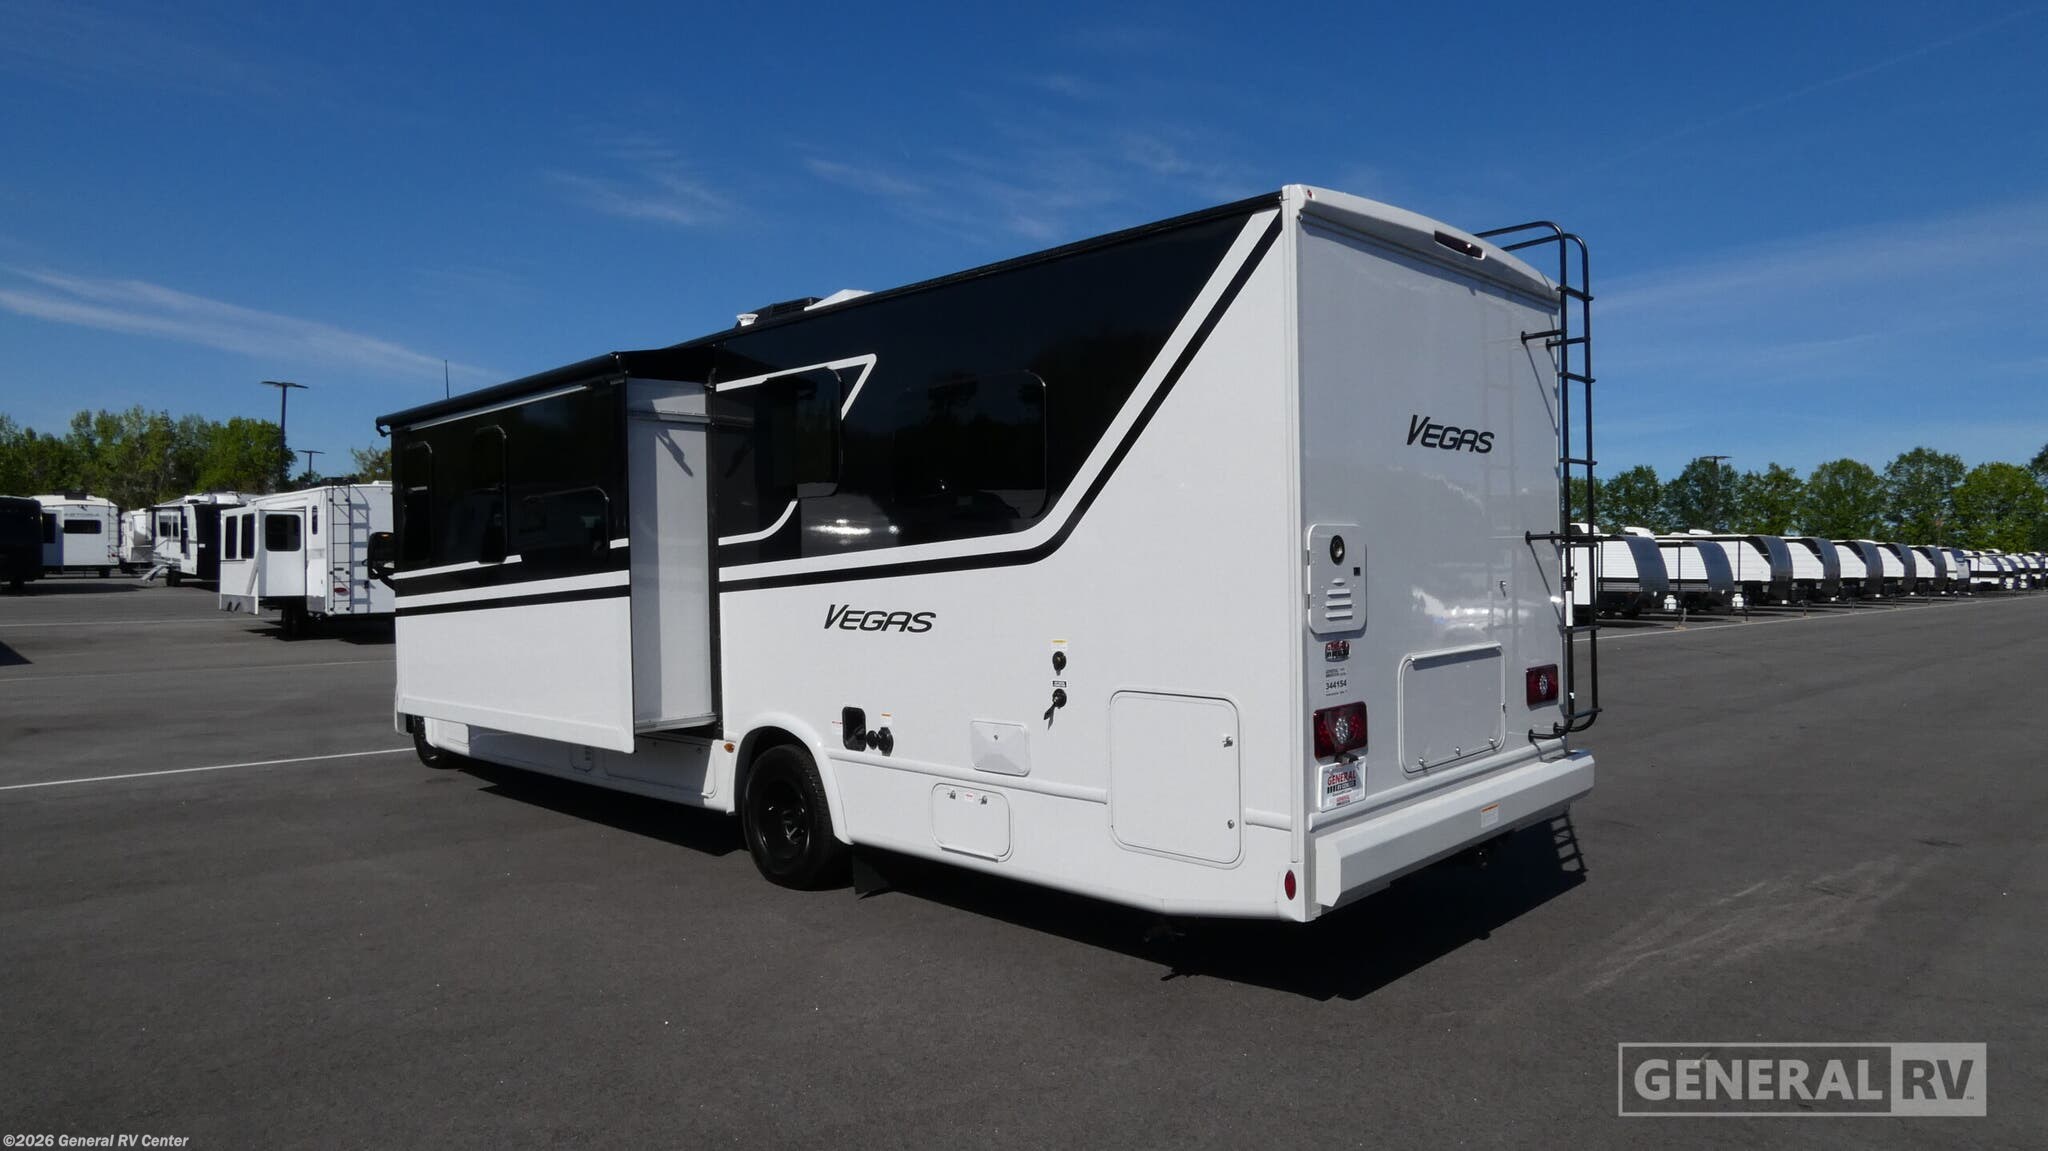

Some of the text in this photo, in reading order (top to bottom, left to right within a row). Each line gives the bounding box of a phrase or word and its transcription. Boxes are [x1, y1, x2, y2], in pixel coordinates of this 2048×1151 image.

[1406, 414, 1495, 454] VEGAS
[823, 604, 937, 633] VEGAS
[1325, 679, 1348, 690] 344154
[1327, 770, 1356, 786] GENERAL
